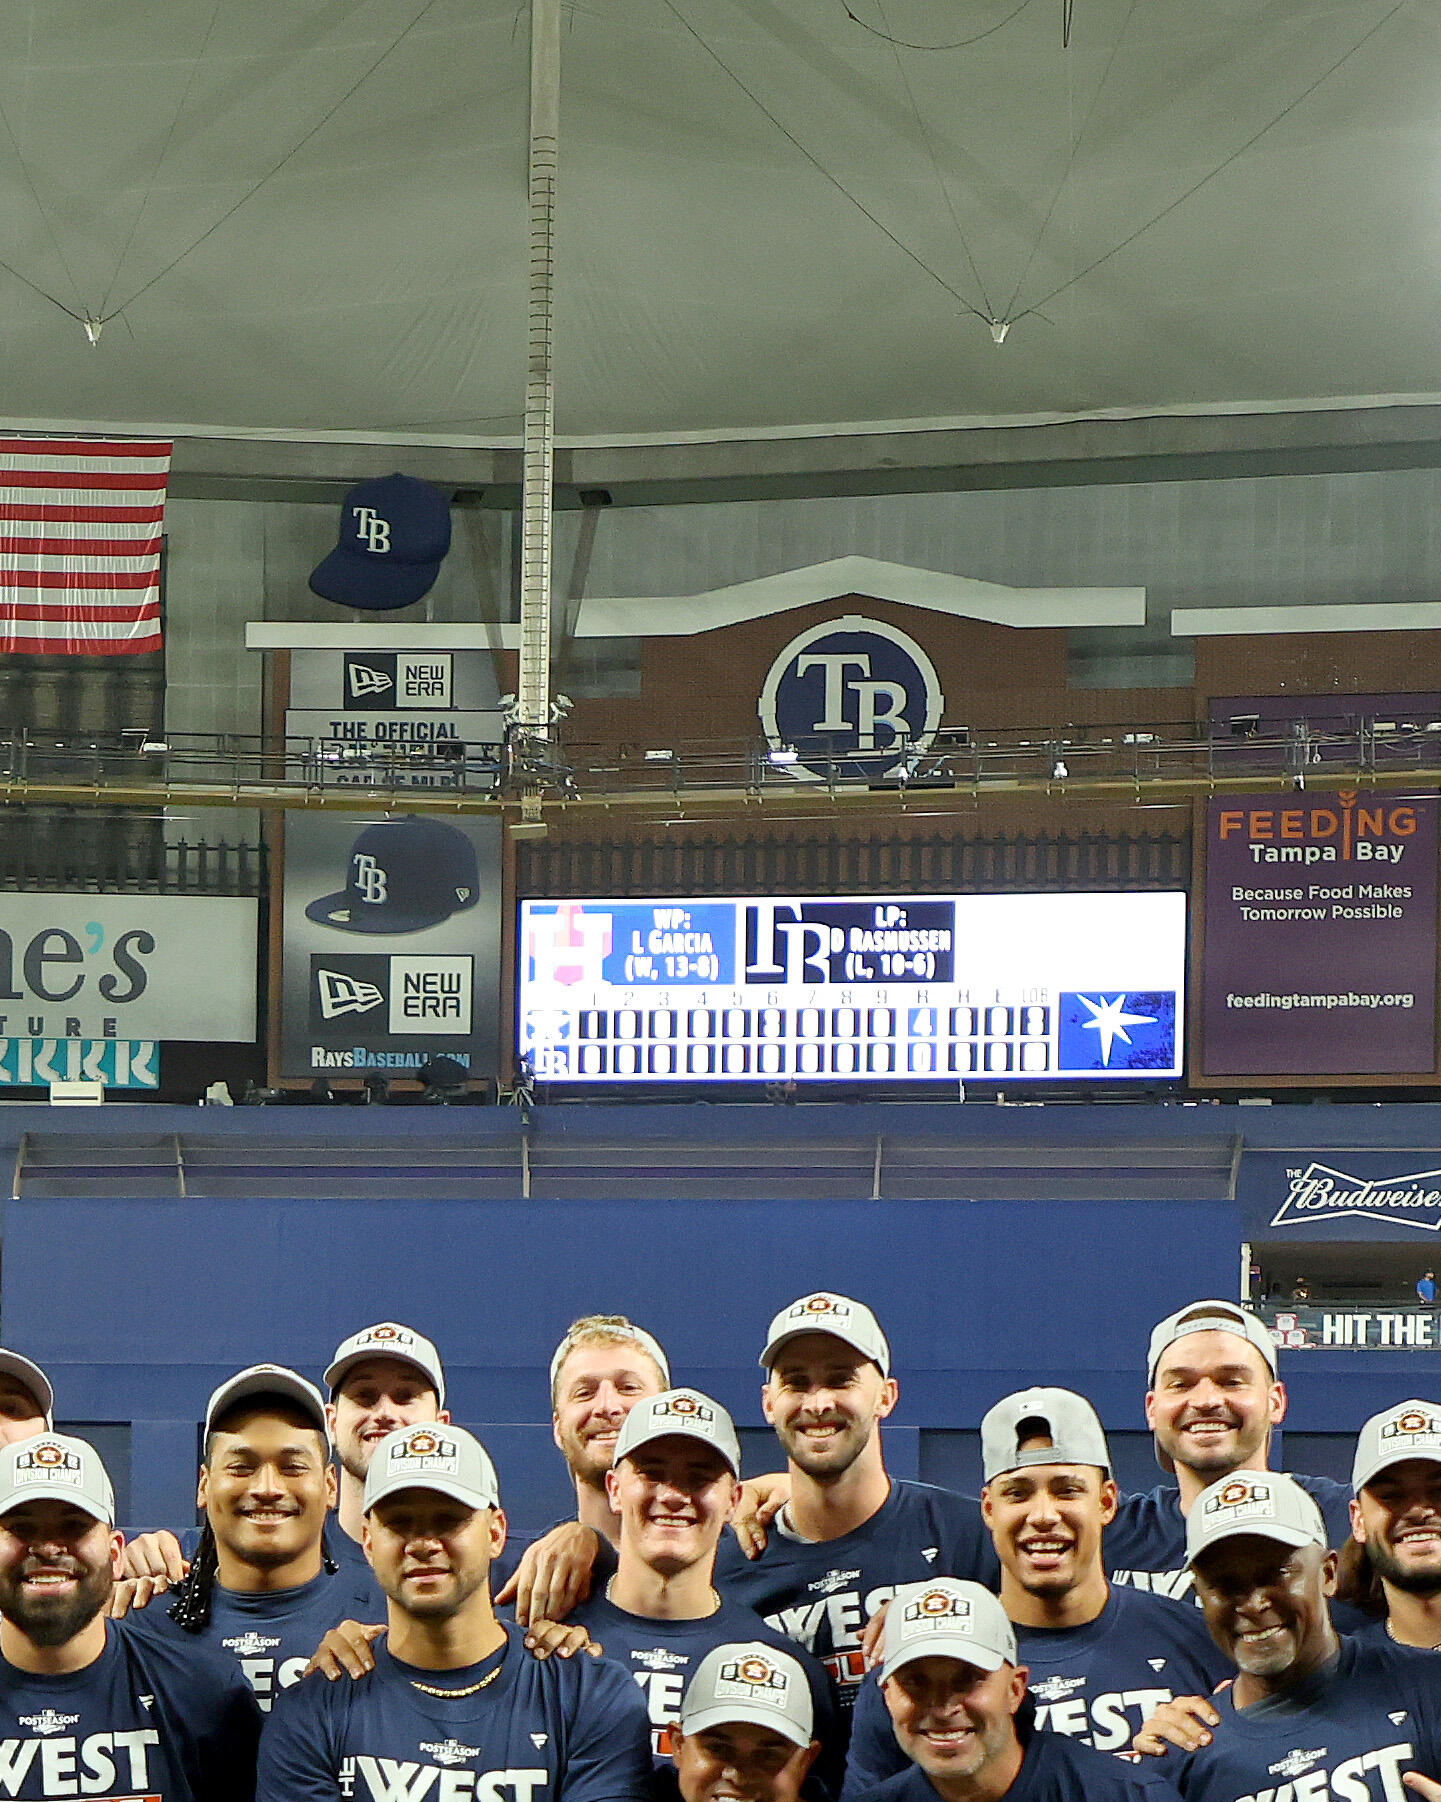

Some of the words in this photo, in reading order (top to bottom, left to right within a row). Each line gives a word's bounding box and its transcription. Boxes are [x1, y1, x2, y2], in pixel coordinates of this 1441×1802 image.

[352, 506, 391, 554] TB
[406, 665, 443, 680] NEW
[406, 681, 443, 696] ERA
[796, 654, 910, 758] TB
[330, 722, 367, 738] THE
[375, 722, 459, 739] OFFICIAL
[1220, 808, 1417, 859] FEEDING
[1249, 844, 1336, 865] Tampa
[1356, 842, 1404, 864] Bay
[354, 854, 388, 903] TB
[1232, 887, 1303, 900] Because
[1309, 885, 1353, 900] Food
[1358, 884, 1412, 899] Makes
[653, 909, 691, 929] WP:
[875, 906, 906, 927] LP:
[1240, 906, 1326, 921] Tomorrow
[1332, 904, 1403, 919] Possible
[632, 931, 644, 954] L
[649, 930, 712, 954] GARCIA
[404, 973, 460, 994] NEW
[404, 996, 460, 1017] ERA
[1226, 992, 1414, 1010] feedingtampabay.org
[1286, 1169, 1302, 1179] THE
[1323, 1314, 1370, 1345] HIT
[1377, 1315, 1432, 1345] THE
[16, 1467, 48, 1485] DIVISION
[49, 1469, 81, 1485] CHAMPS
[19, 1715, 78, 1726] POSTSEASON
